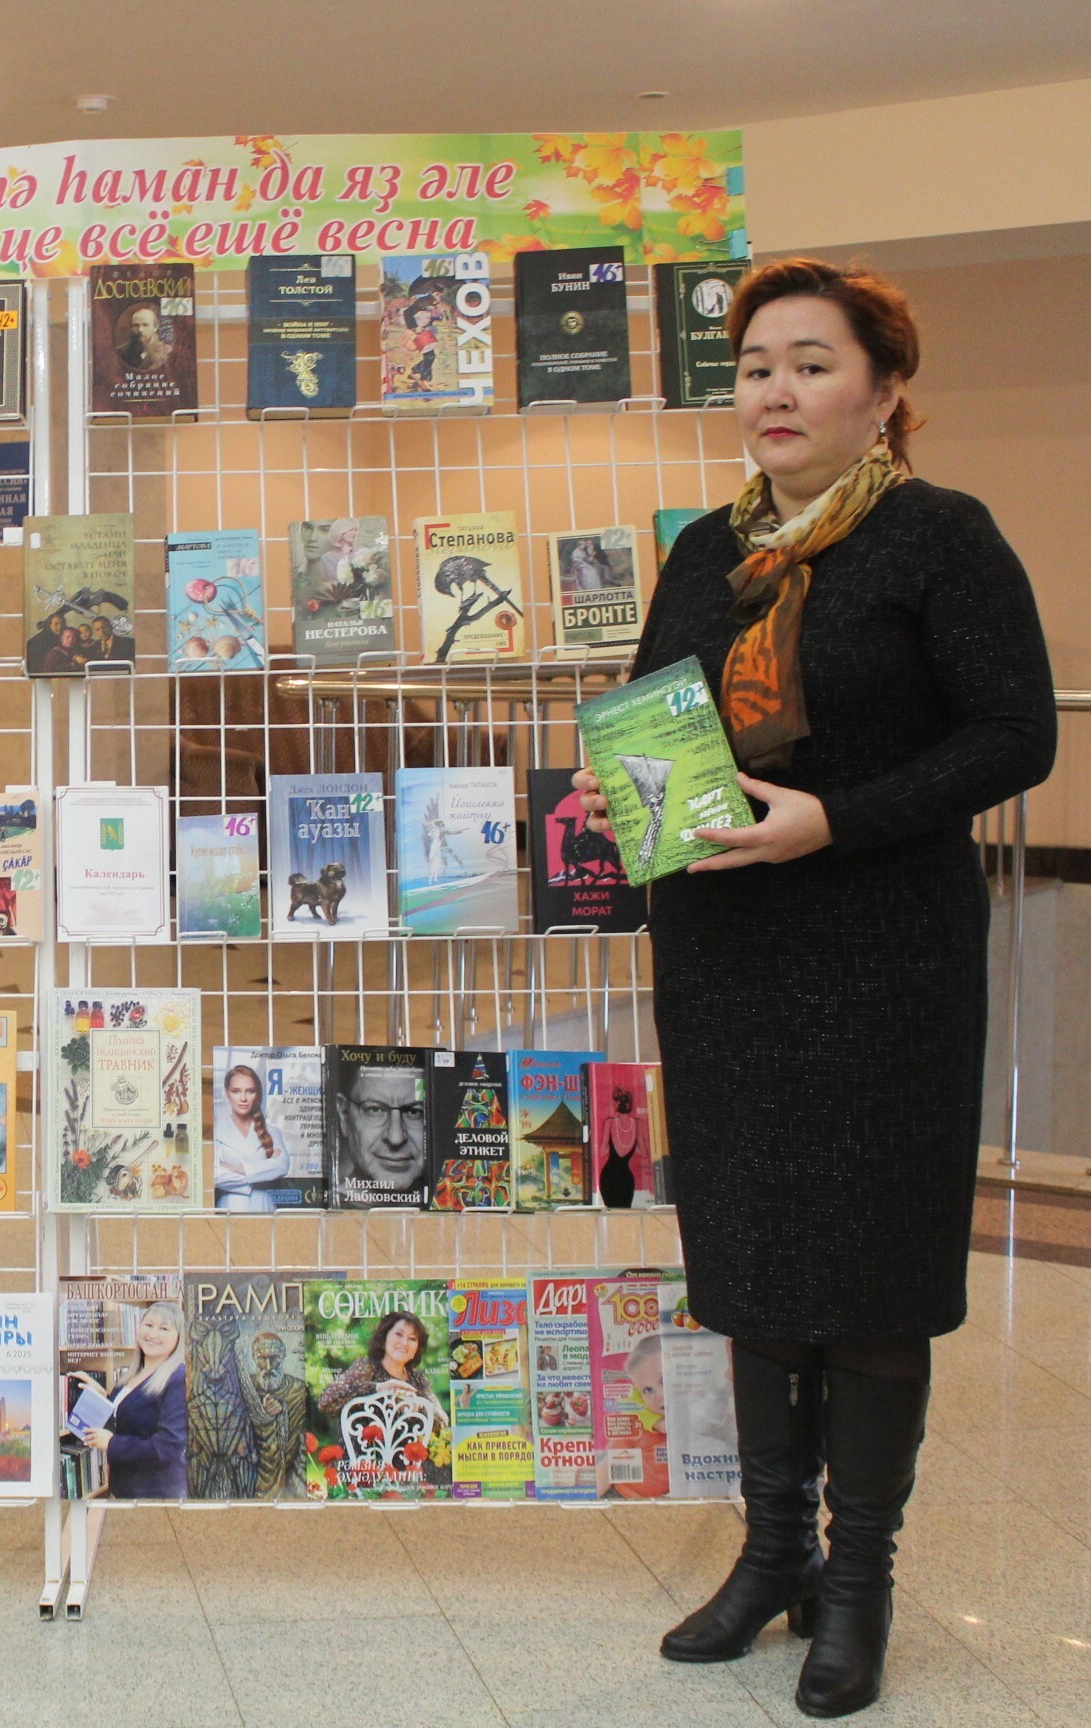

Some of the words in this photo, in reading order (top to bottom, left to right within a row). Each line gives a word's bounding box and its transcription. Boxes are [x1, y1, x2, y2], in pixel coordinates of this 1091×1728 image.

[56, 154, 239, 207] һаман
[259, 149, 323, 200] да
[336, 164, 400, 214] яҙ
[419, 163, 515, 199] әле
[79, 209, 170, 260] всё
[184, 208, 305, 257] ещё
[317, 217, 475, 252] весна
[295, 275, 316, 284] Лев
[558, 272, 582, 280] Иван
[93, 278, 192, 299] ДОСТОЕВСКИЙ
[278, 284, 333, 295] ТОЛСТОЙ
[551, 281, 590, 293] БУНИН
[455, 253, 492, 407] ЧЕХОВ
[125, 372, 165, 380] Малое
[114, 380, 175, 389] собрание
[110, 388, 180, 397] сочинений
[429, 530, 515, 548] Степанова
[574, 591, 633, 604] ШАРЛОТТА
[563, 604, 636, 628] БРОНТЕ
[305, 625, 388, 640] НЕСТЕРОВА
[595, 702, 629, 722] ЭРНЕСТ
[631, 677, 687, 705] ХЕМИНГУЭЙ
[318, 784, 368, 794] ЛОНДОН
[298, 822, 360, 843] ауазы
[85, 868, 145, 881] Календарь
[573, 892, 609, 901] ХАЖИ
[572, 906, 614, 916] МОРАТ
[341, 1050, 371, 1063] Хочу
[389, 1051, 416, 1064] буду
[98, 1059, 155, 1071] ТРАВНИК
[268, 1069, 283, 1096] Я
[455, 1132, 508, 1144] ДЕЛОВОЙ
[460, 1146, 505, 1156] ЭТИКЕТ
[345, 1177, 394, 1189] Михаил
[344, 1191, 420, 1203] Лабковский
[197, 1283, 303, 1313] РАМП
[535, 1321, 552, 1329] Тело
[467, 1441, 483, 1450] КАК
[486, 1441, 527, 1451] ПРИВЕСТИ
[458, 1452, 488, 1462] МЫСЛИ
